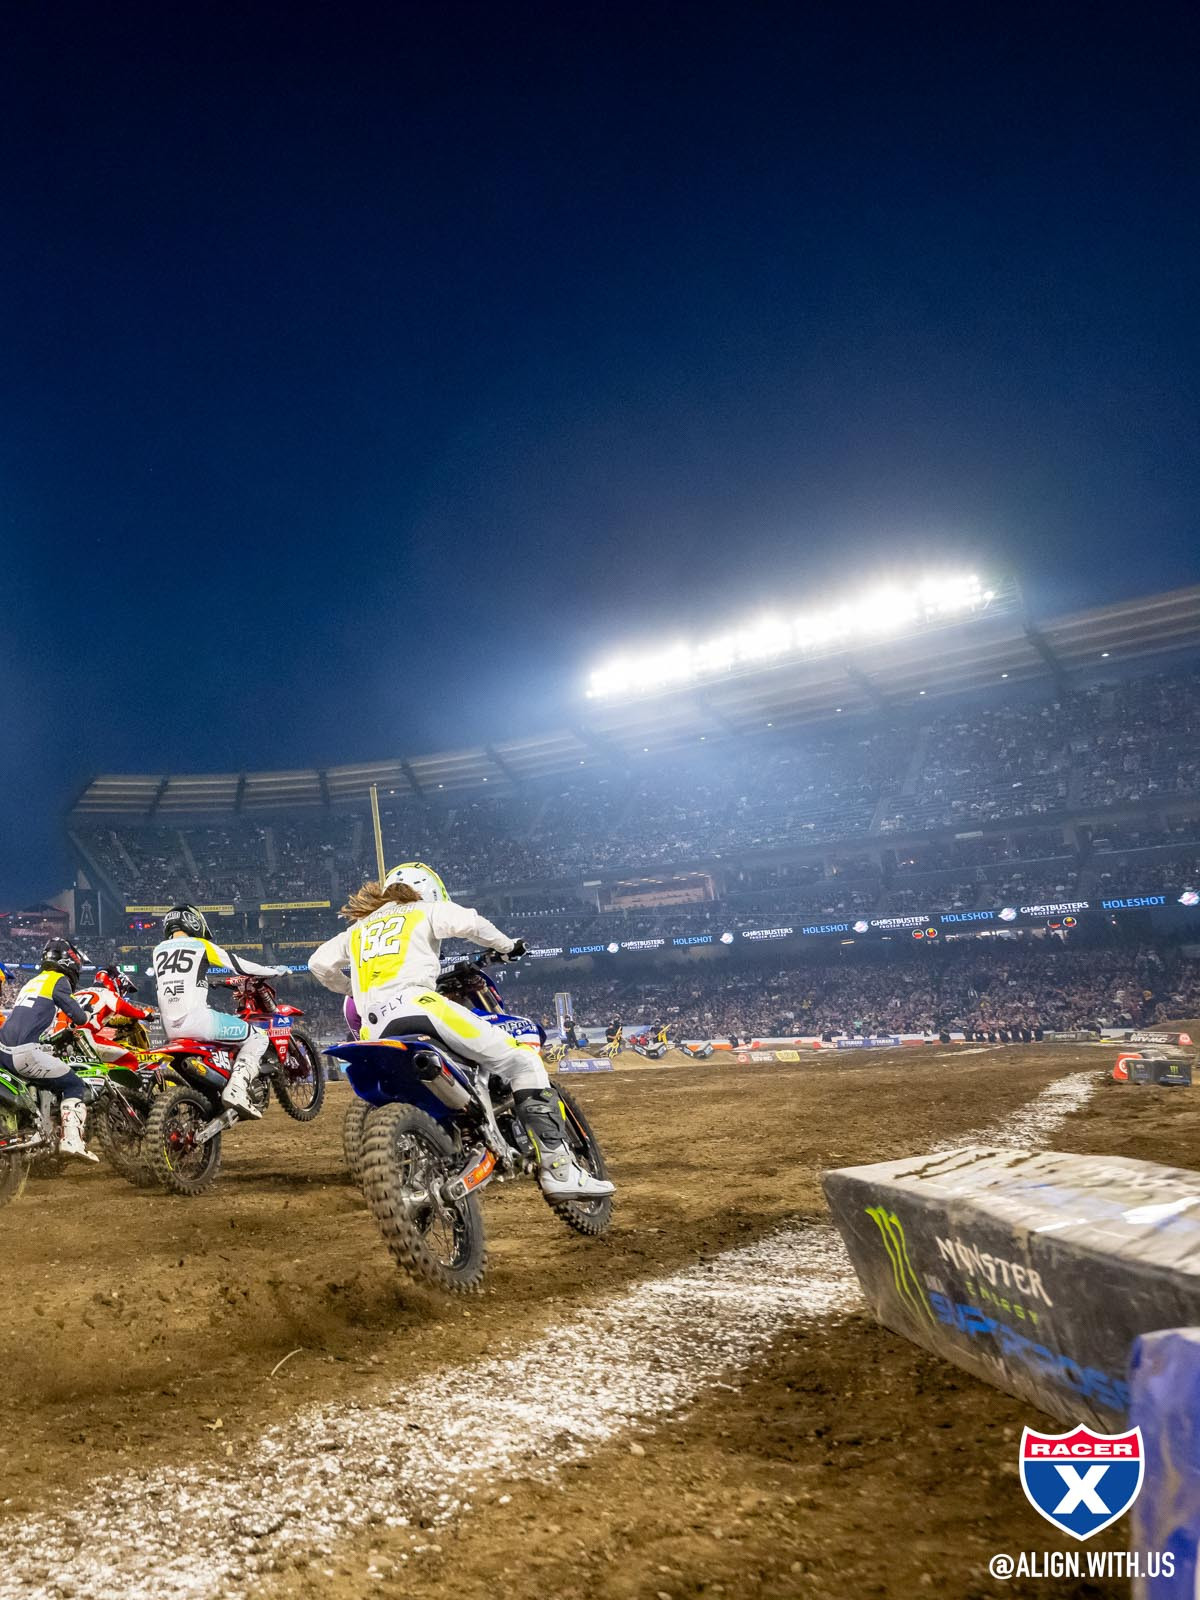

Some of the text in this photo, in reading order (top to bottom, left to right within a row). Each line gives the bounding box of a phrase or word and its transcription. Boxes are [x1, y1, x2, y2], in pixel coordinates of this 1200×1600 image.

[1020, 895, 1166, 914] GHOSTBUSTERS HOLESHOT
[871, 911, 994, 927] GHOSTBUSTERS HOLESHOT
[570, 944, 604, 954] HOLESHOT
[673, 935, 713, 945] HOLESHOT
[742, 927, 793, 938] GHOSTBUSTERS
[803, 923, 849, 934] HOLESHOT
[156, 949, 197, 977] 245
[164, 985, 185, 996] AJE
[380, 995, 404, 1017] FLY
[935, 1236, 1053, 1308] MONSTER
